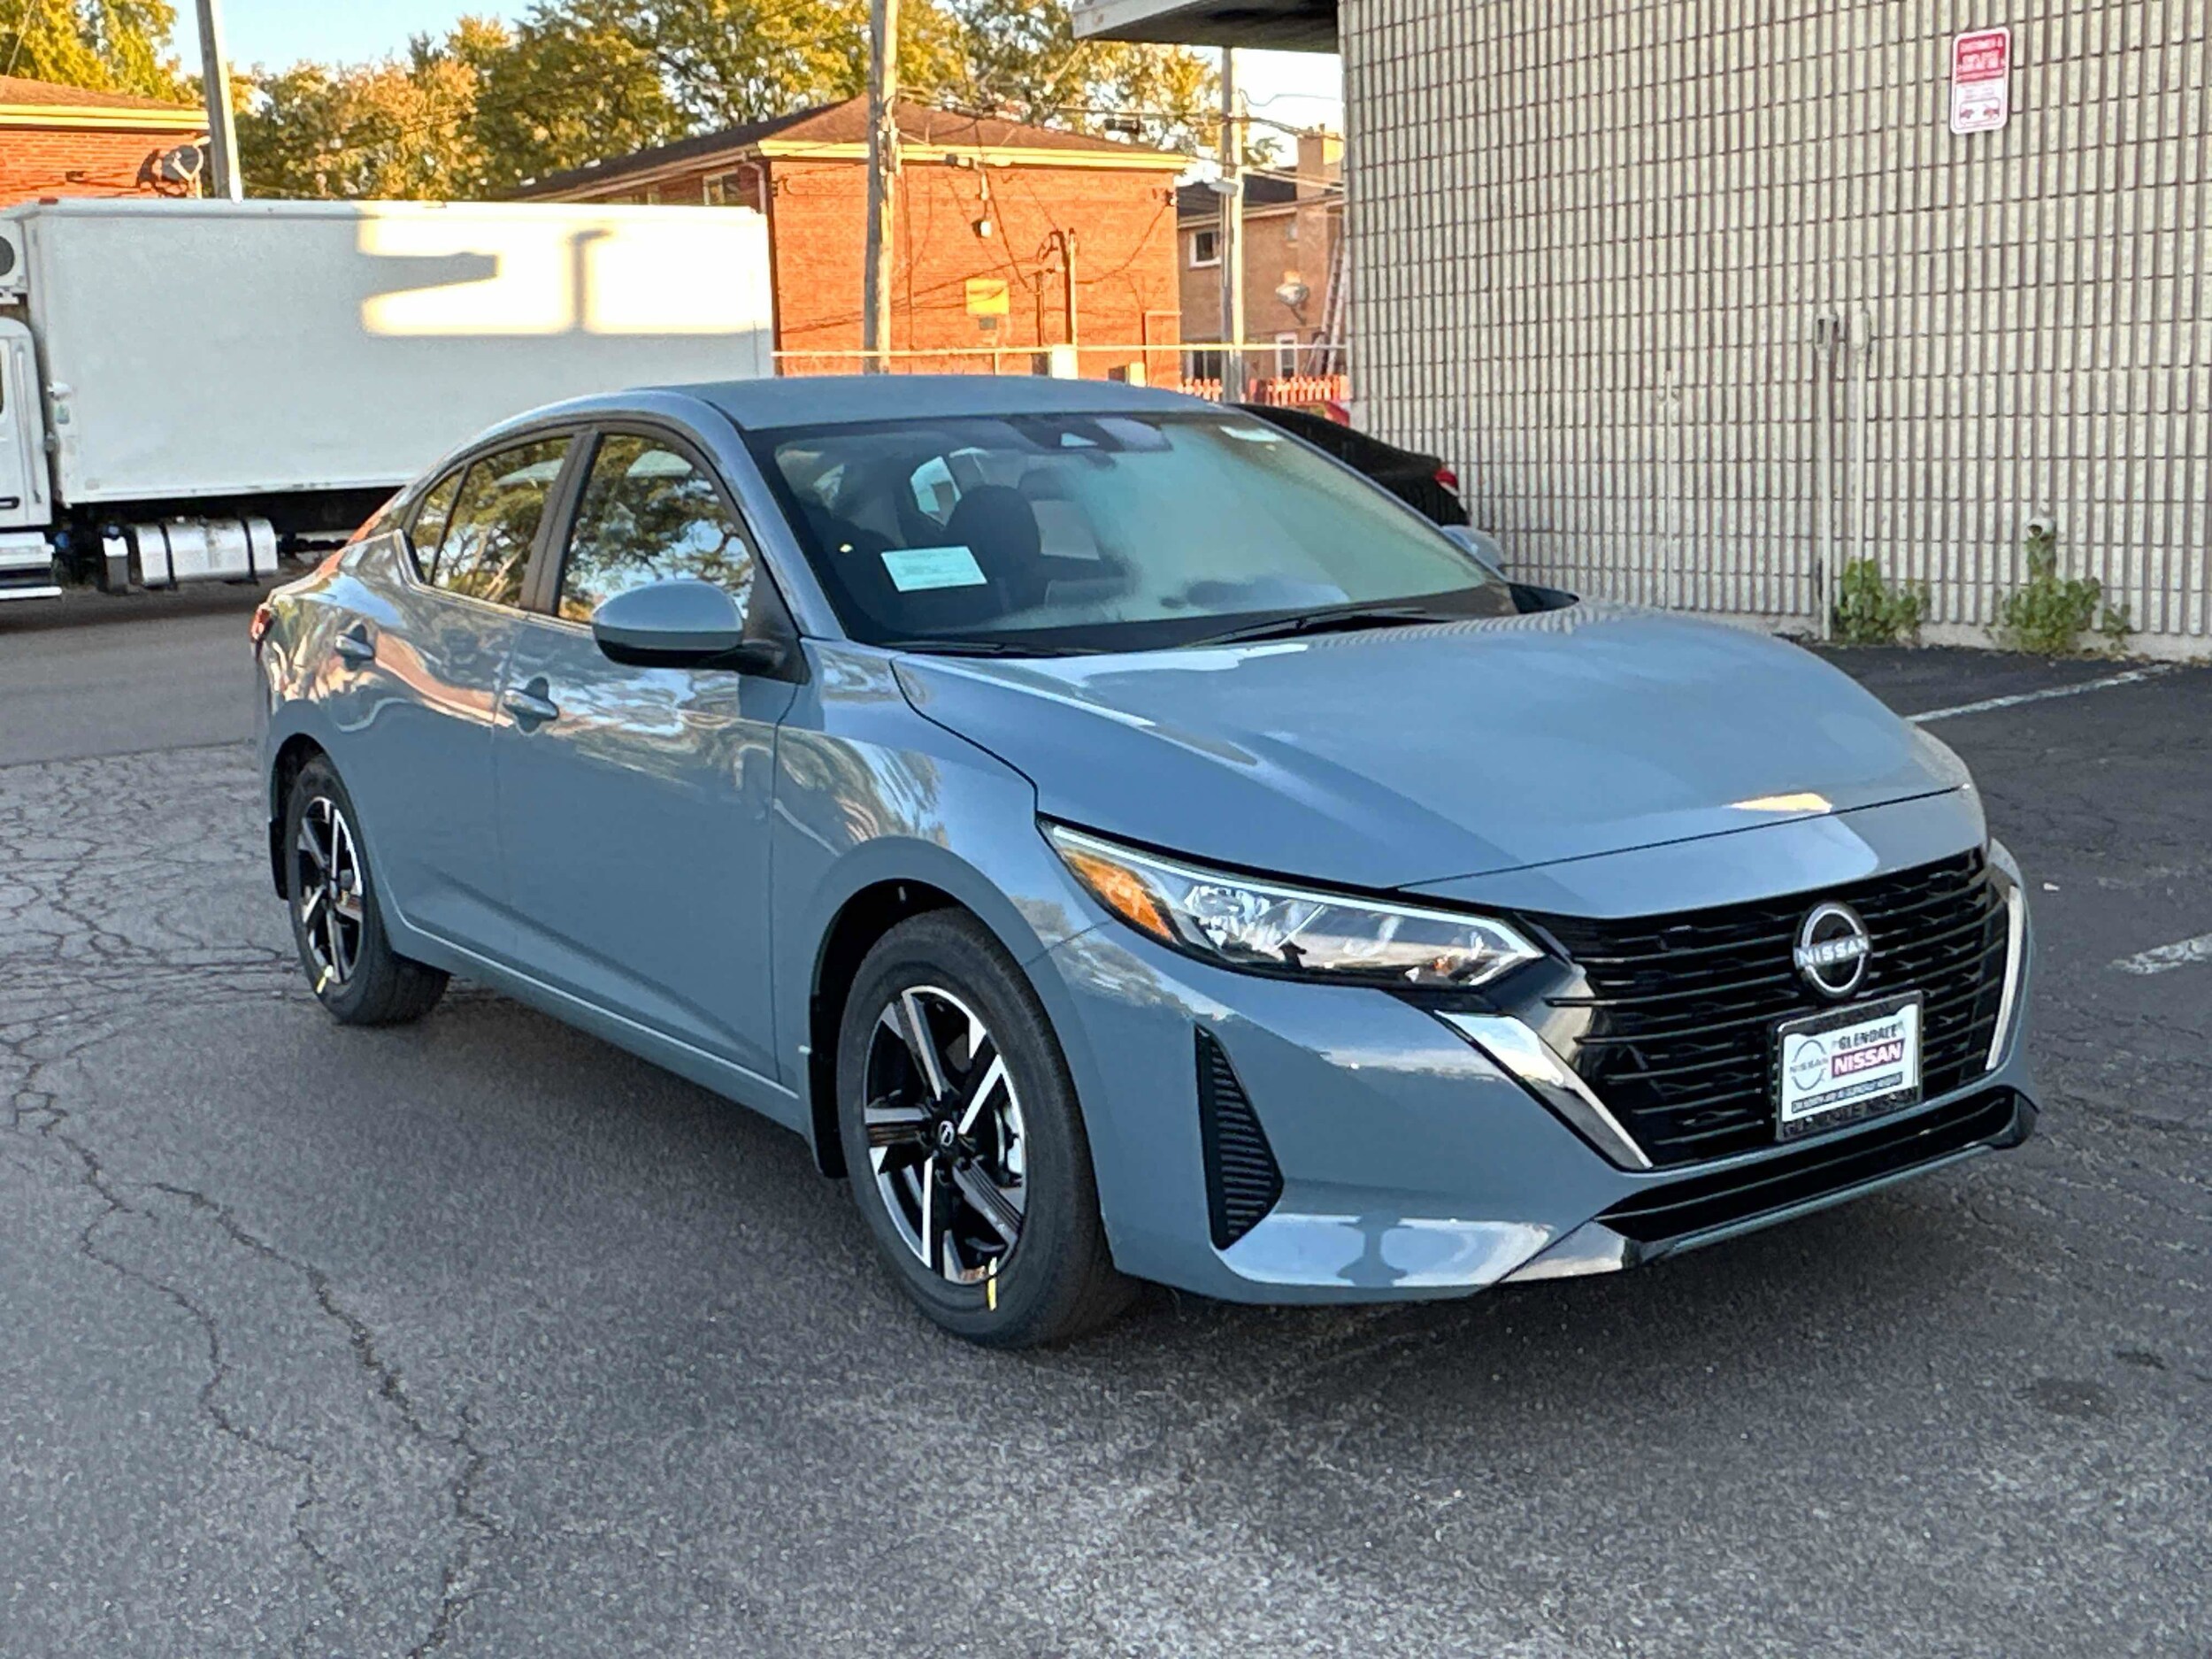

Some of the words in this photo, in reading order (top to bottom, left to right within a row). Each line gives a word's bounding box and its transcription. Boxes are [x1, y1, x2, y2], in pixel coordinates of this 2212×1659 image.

[1797, 939, 1870, 966] NISSAN
[1838, 1024, 1898, 1050] GLENDALE
[1834, 1043, 1902, 1075] NISSAN
